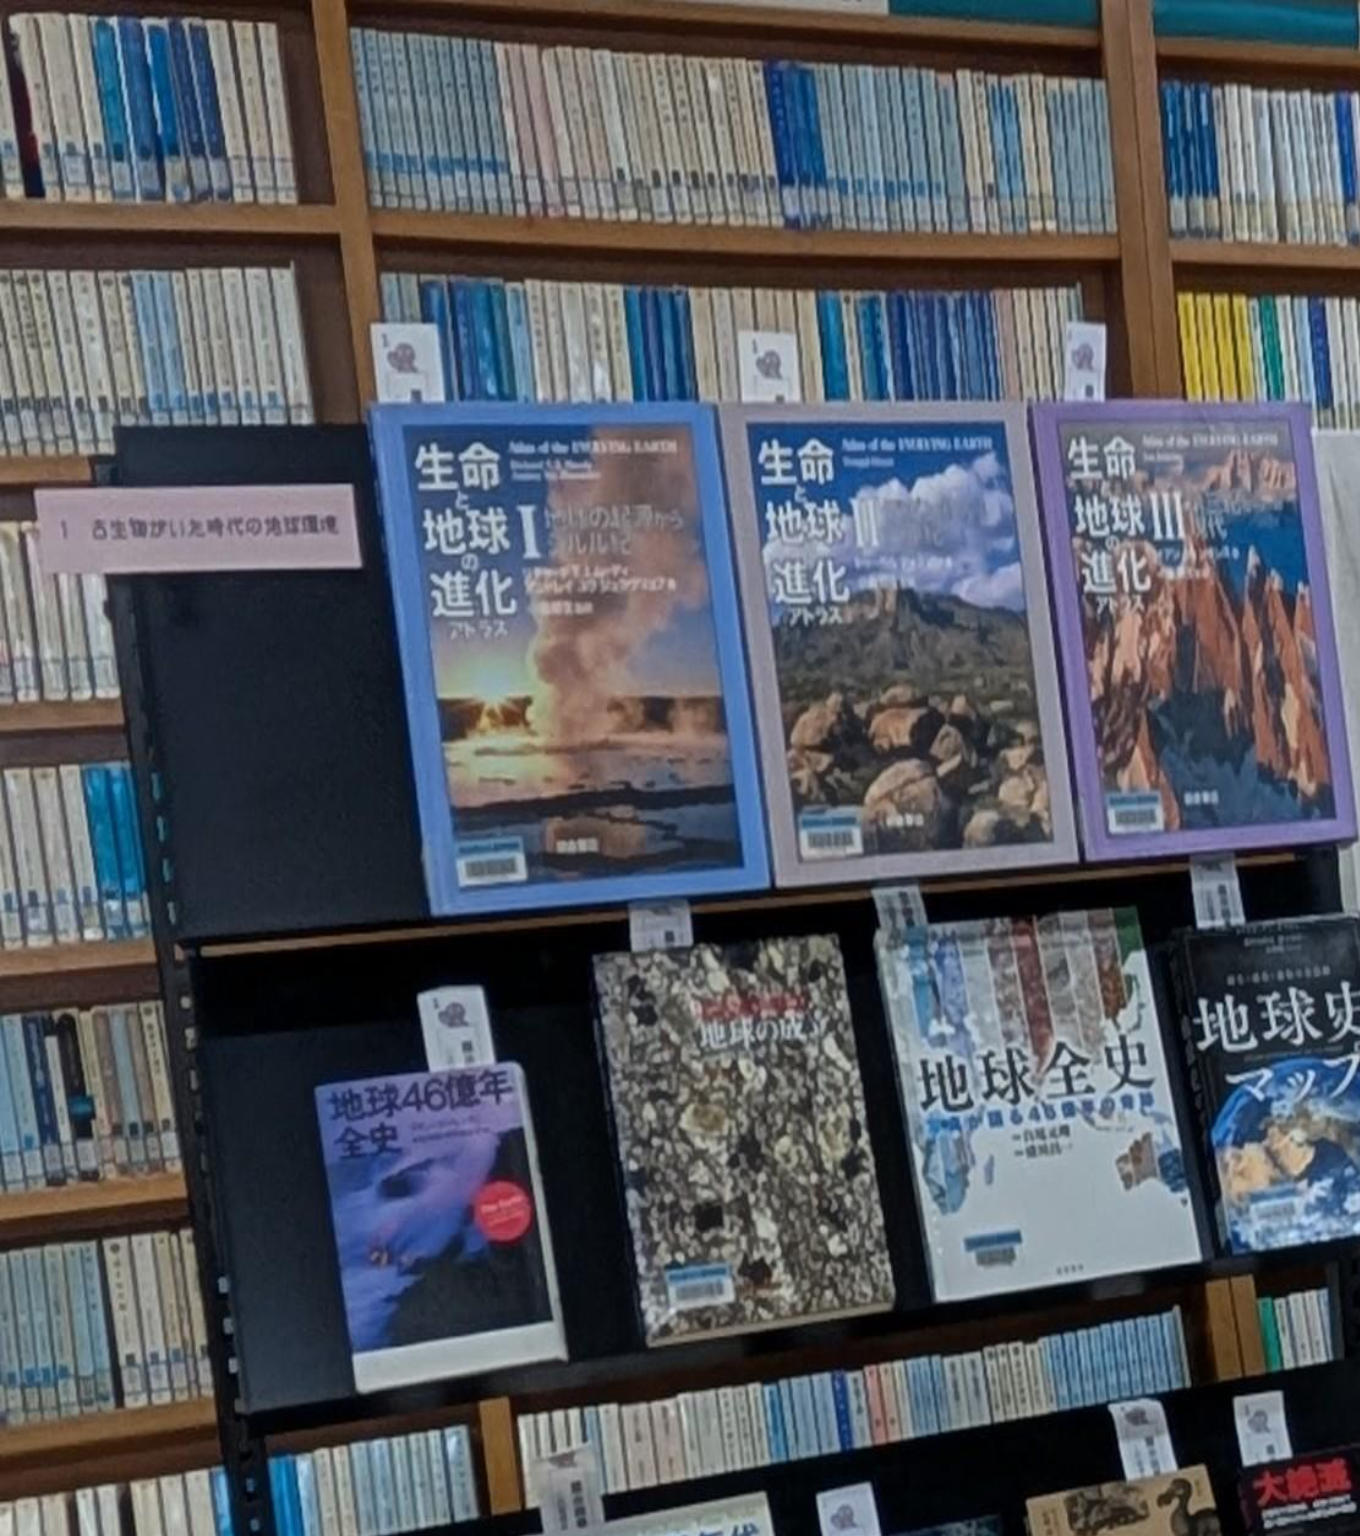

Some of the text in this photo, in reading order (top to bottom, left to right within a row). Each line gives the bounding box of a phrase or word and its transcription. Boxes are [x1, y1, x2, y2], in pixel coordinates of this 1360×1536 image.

[415, 441, 500, 491] 生命
[759, 438, 834, 485] 生命
[1067, 436, 1135, 480] 生命
[423, 506, 510, 555] 地球
[766, 499, 843, 544] 地球
[1074, 494, 1145, 537] 地球
[461, 554, 478, 571] の
[773, 560, 850, 604] 進化
[1081, 549, 1151, 593] 進化
[430, 569, 517, 617] 進化
[450, 620, 508, 640] アトラス
[331, 1069, 513, 1121] 地球46億年
[917, 1035, 1156, 1112] 地球全史
[334, 1123, 403, 1159] 全史
